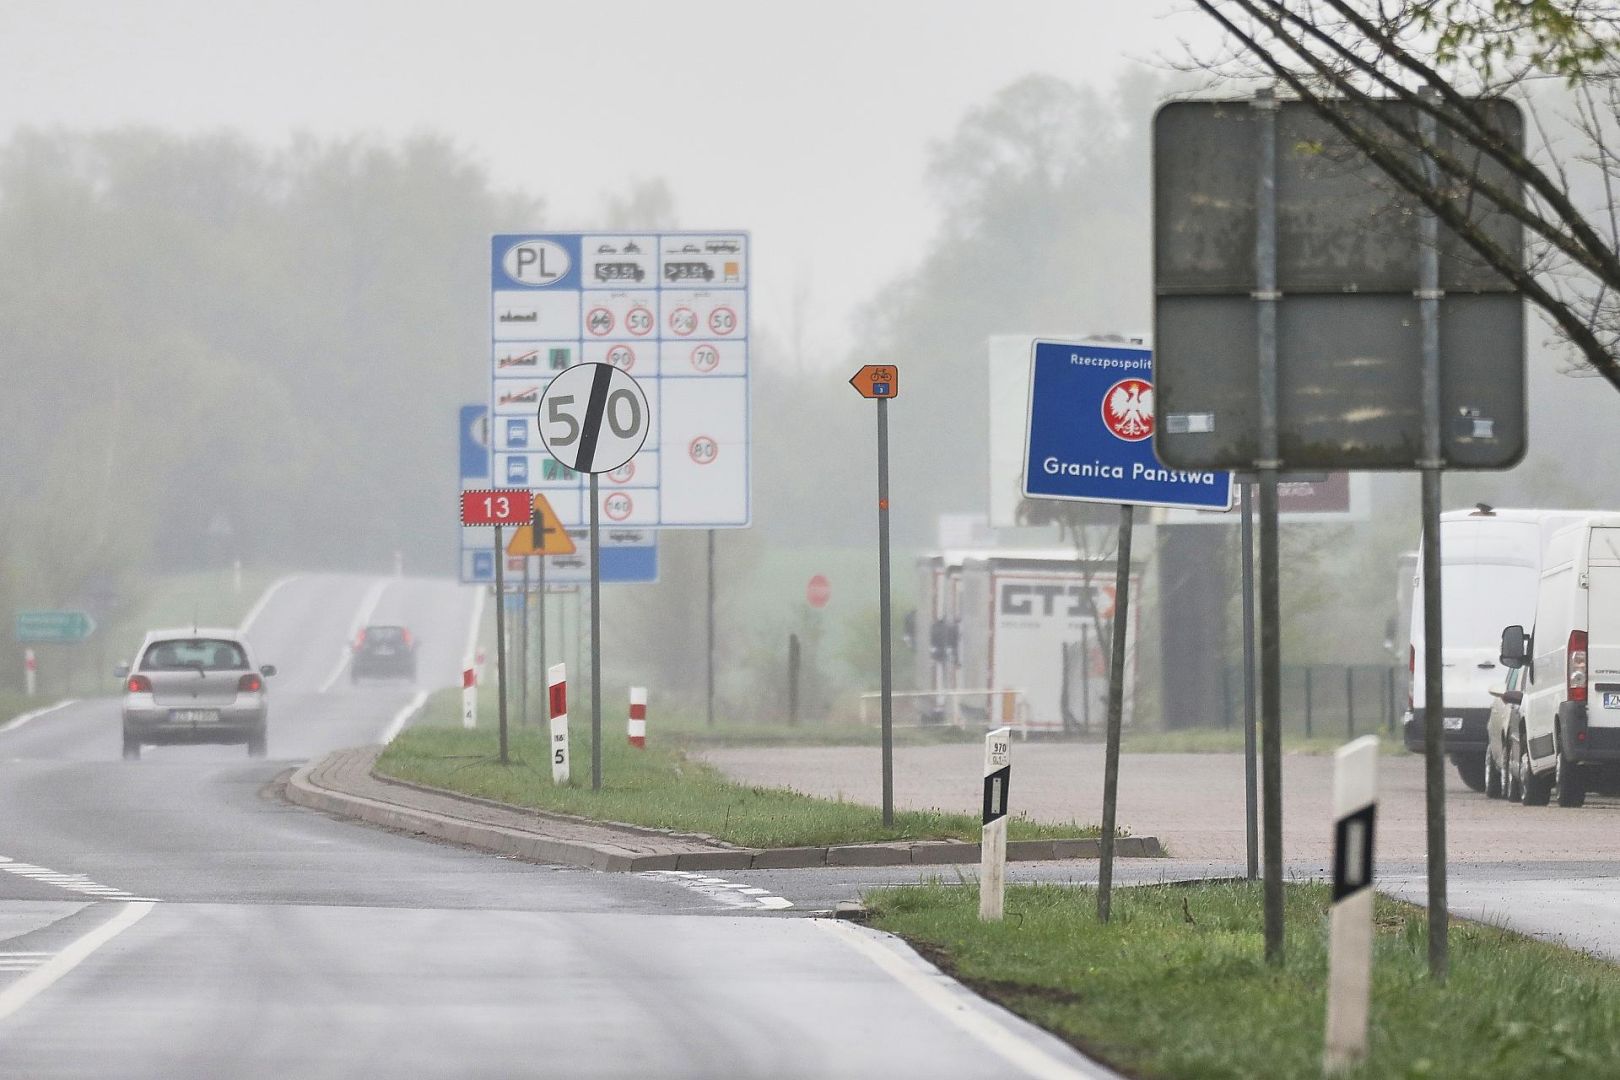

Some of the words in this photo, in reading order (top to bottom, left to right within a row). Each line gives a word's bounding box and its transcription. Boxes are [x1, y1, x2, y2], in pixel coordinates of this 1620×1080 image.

[517, 247, 557, 278] PL
[630, 314, 649, 328] 50
[713, 314, 732, 328] 50
[611, 351, 631, 366] 90
[697, 351, 715, 366] 70
[1070, 353, 1153, 371] Rzeczpospolit
[694, 443, 714, 458] 80
[1043, 456, 1124, 480] Granica
[483, 496, 510, 519] 13
[994, 743, 1006, 752] 970
[555, 749, 564, 764] 5
